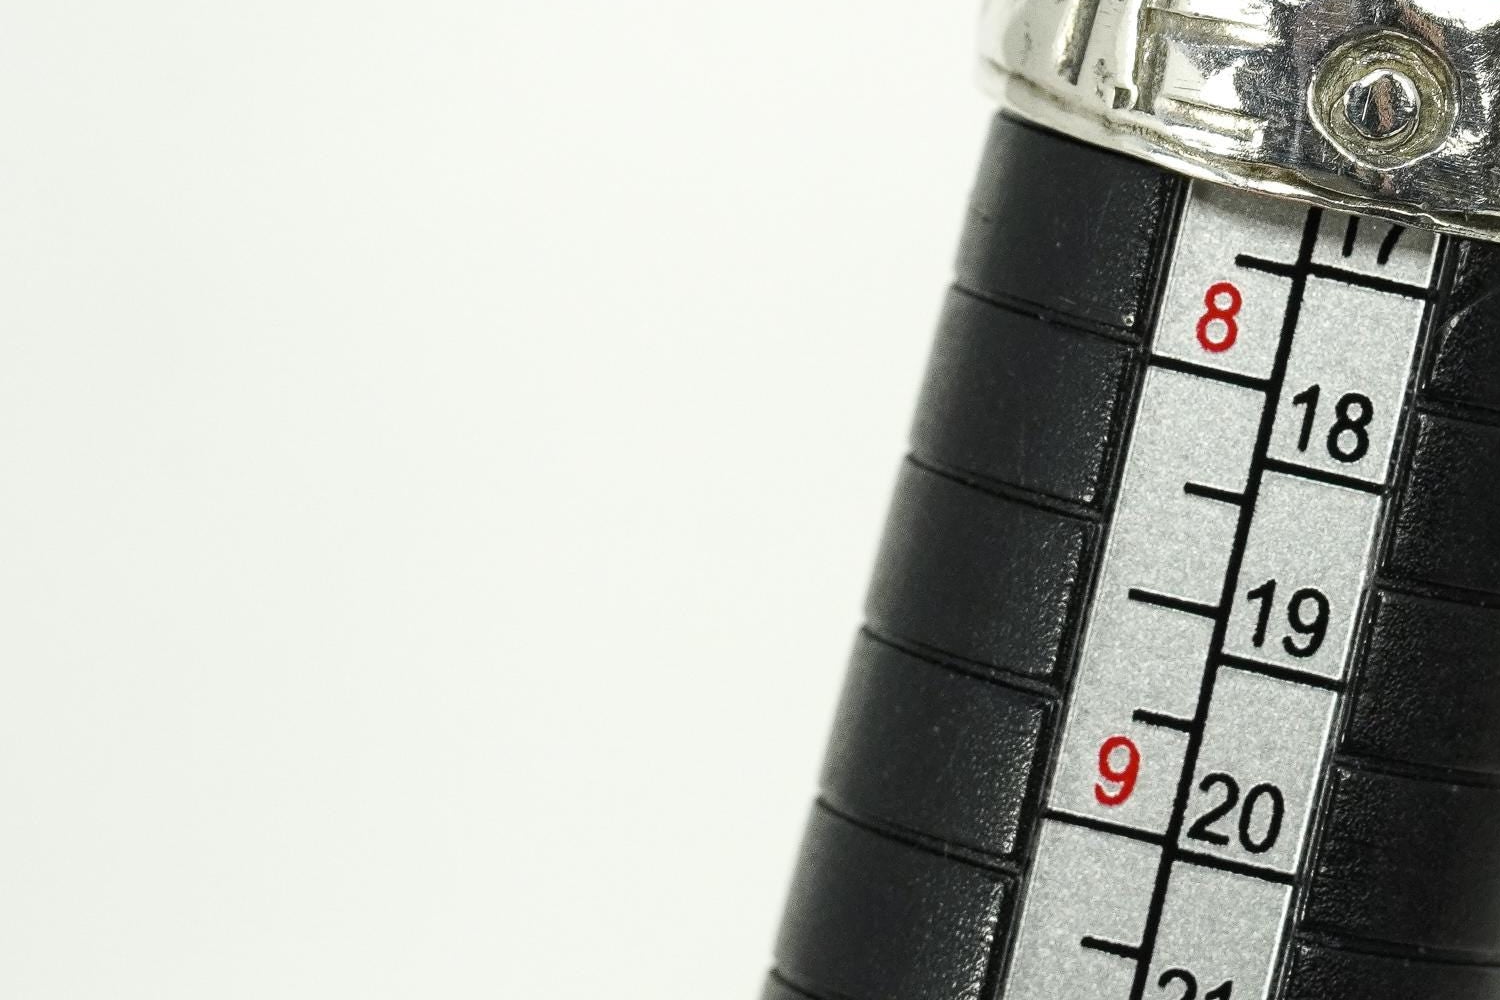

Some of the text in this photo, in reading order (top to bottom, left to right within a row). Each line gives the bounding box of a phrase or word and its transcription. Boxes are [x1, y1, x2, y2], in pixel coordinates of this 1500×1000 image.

[1195, 281, 1243, 354] 8
[1292, 384, 1374, 464] 18
[1246, 578, 1331, 659] 19
[1094, 735, 1141, 807] 9
[1186, 772, 1285, 855] 20
